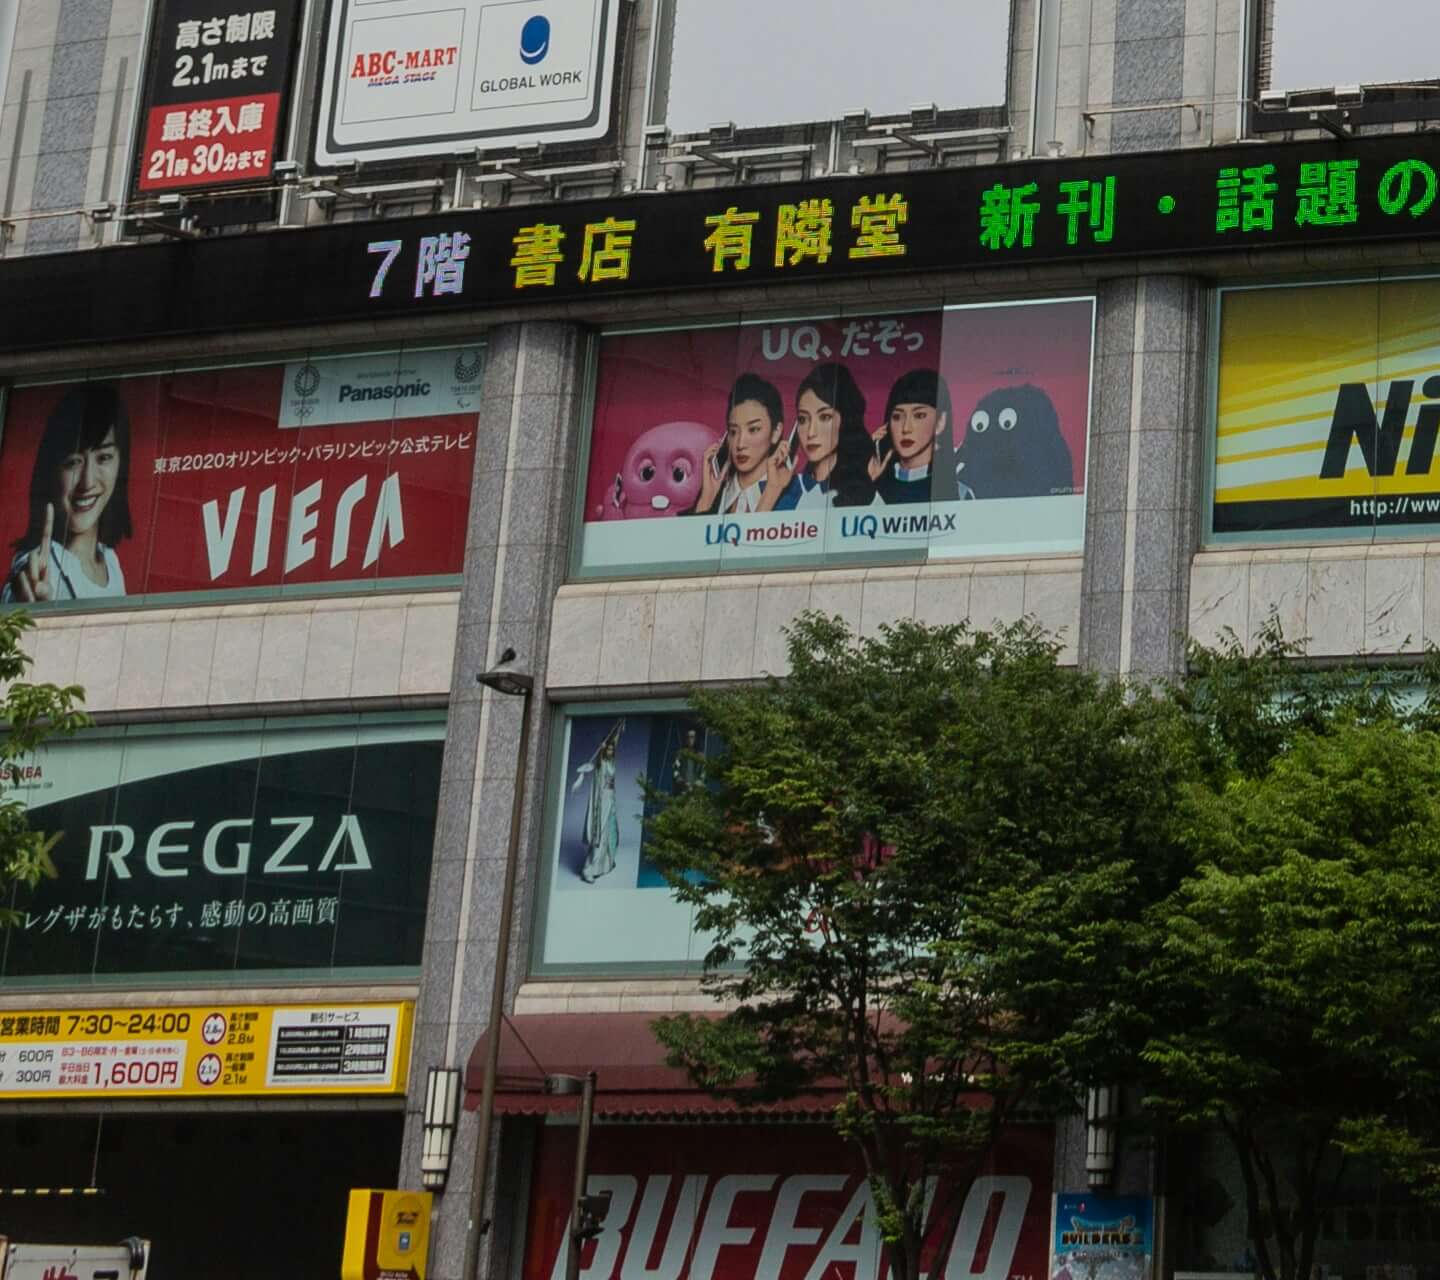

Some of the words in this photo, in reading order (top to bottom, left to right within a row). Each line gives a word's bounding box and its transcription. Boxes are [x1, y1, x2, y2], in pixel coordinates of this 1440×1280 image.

[175, 9, 276, 50] 高さ制限
[171, 53, 268, 89] 2.1mまで
[350, 46, 458, 80] ABC-MART
[479, 74, 536, 94] GLOBAL
[538, 70, 583, 88] WORK
[160, 100, 265, 144] 最終入庫
[365, 230, 471, 299] 7階
[509, 217, 638, 291] 書店
[700, 192, 910, 272] 有隣堂
[338, 378, 431, 403] Panasonic
[201, 471, 406, 582] VIERA
[704, 521, 741, 547] UQ
[746, 519, 819, 542] mobile
[840, 513, 878, 539] UQ
[881, 511, 957, 533] WiMAX
[84, 814, 373, 880] REGZA
[23, 896, 340, 935] レグザがもたらす、感動の高画質
[92, 1060, 179, 1088] 1,600円
